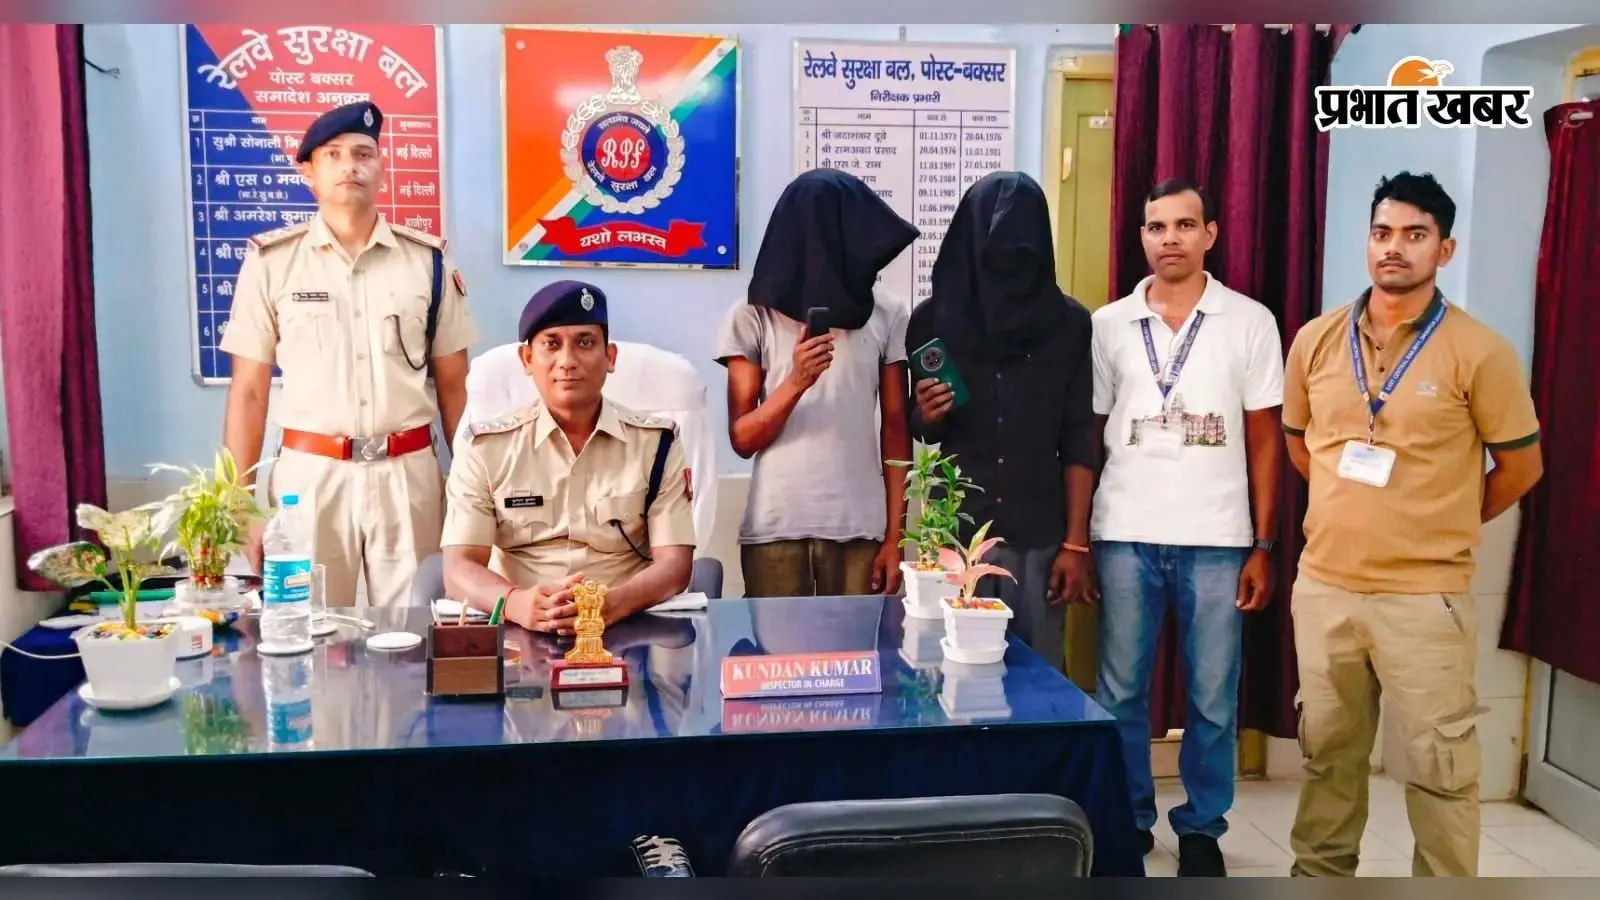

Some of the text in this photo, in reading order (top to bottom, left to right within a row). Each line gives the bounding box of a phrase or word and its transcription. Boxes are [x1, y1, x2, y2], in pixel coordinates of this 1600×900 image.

[197, 25, 429, 99] रेलवे सुरक्षा बल
[803, 49, 837, 79] रेलवे
[841, 59, 882, 90] सुरक्षा
[268, 67, 354, 86] पोस्ट बक्सर
[254, 86, 311, 104] समादेश
[912, 90, 940, 104] प्रभारी
[240, 134, 281, 148] सोनाली
[821, 128, 831, 140] श्री
[821, 143, 831, 154] श्री
[196, 174, 202, 185] 2
[215, 169, 230, 186] श्री
[233, 174, 258, 186] एस
[412, 180, 435, 196] दिल्ली
[198, 212, 204, 222] 3
[214, 206, 229, 221] श्री
[234, 206, 276, 222] अमरेश
[580, 227, 667, 250] यशो लभस्व
[216, 243, 232, 259] श्री
[202, 284, 208, 294] 5
[217, 280, 232, 296] श्री
[204, 326, 210, 336] 6
[732, 658, 872, 680] KUNDAN KUMAR
[762, 680, 802, 690] INSPECTOR
